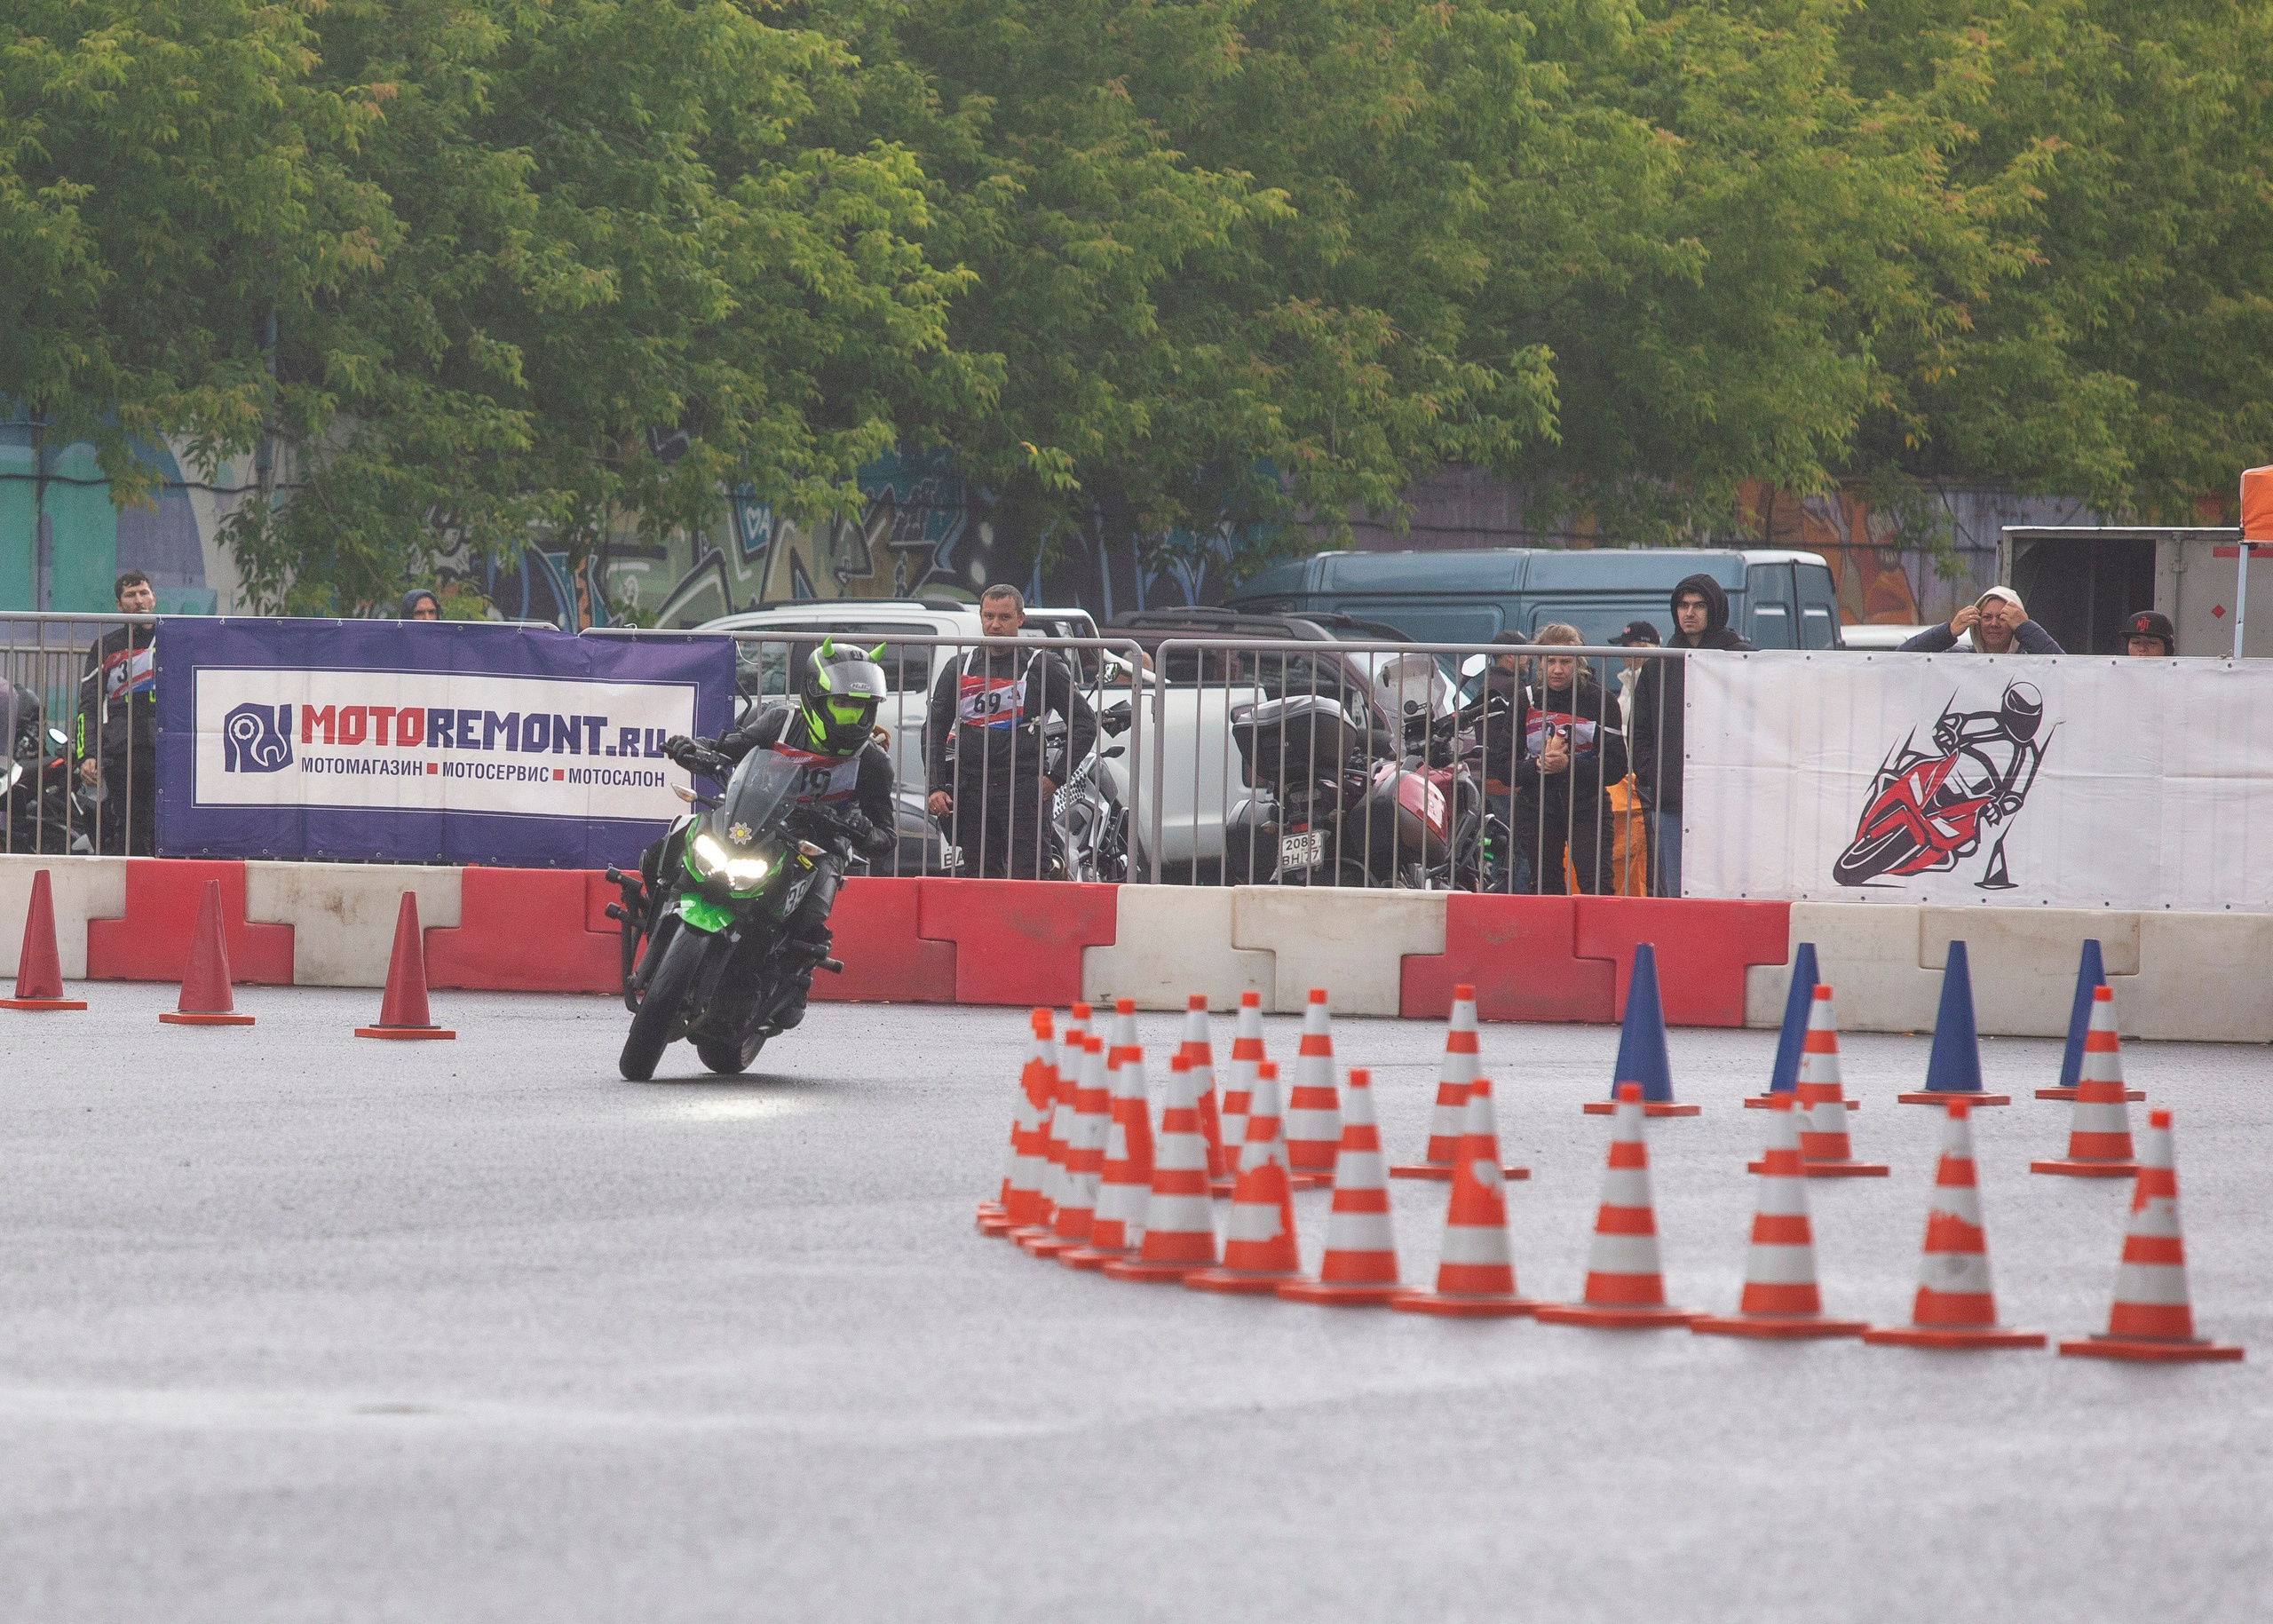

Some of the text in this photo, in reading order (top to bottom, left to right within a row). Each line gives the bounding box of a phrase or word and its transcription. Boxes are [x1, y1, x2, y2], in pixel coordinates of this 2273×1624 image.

[974, 692, 1002, 715] 69
[301, 757, 665, 788] МОТОМАГАЗИН МОТОСЕРВИС МОТОСАЛОН
